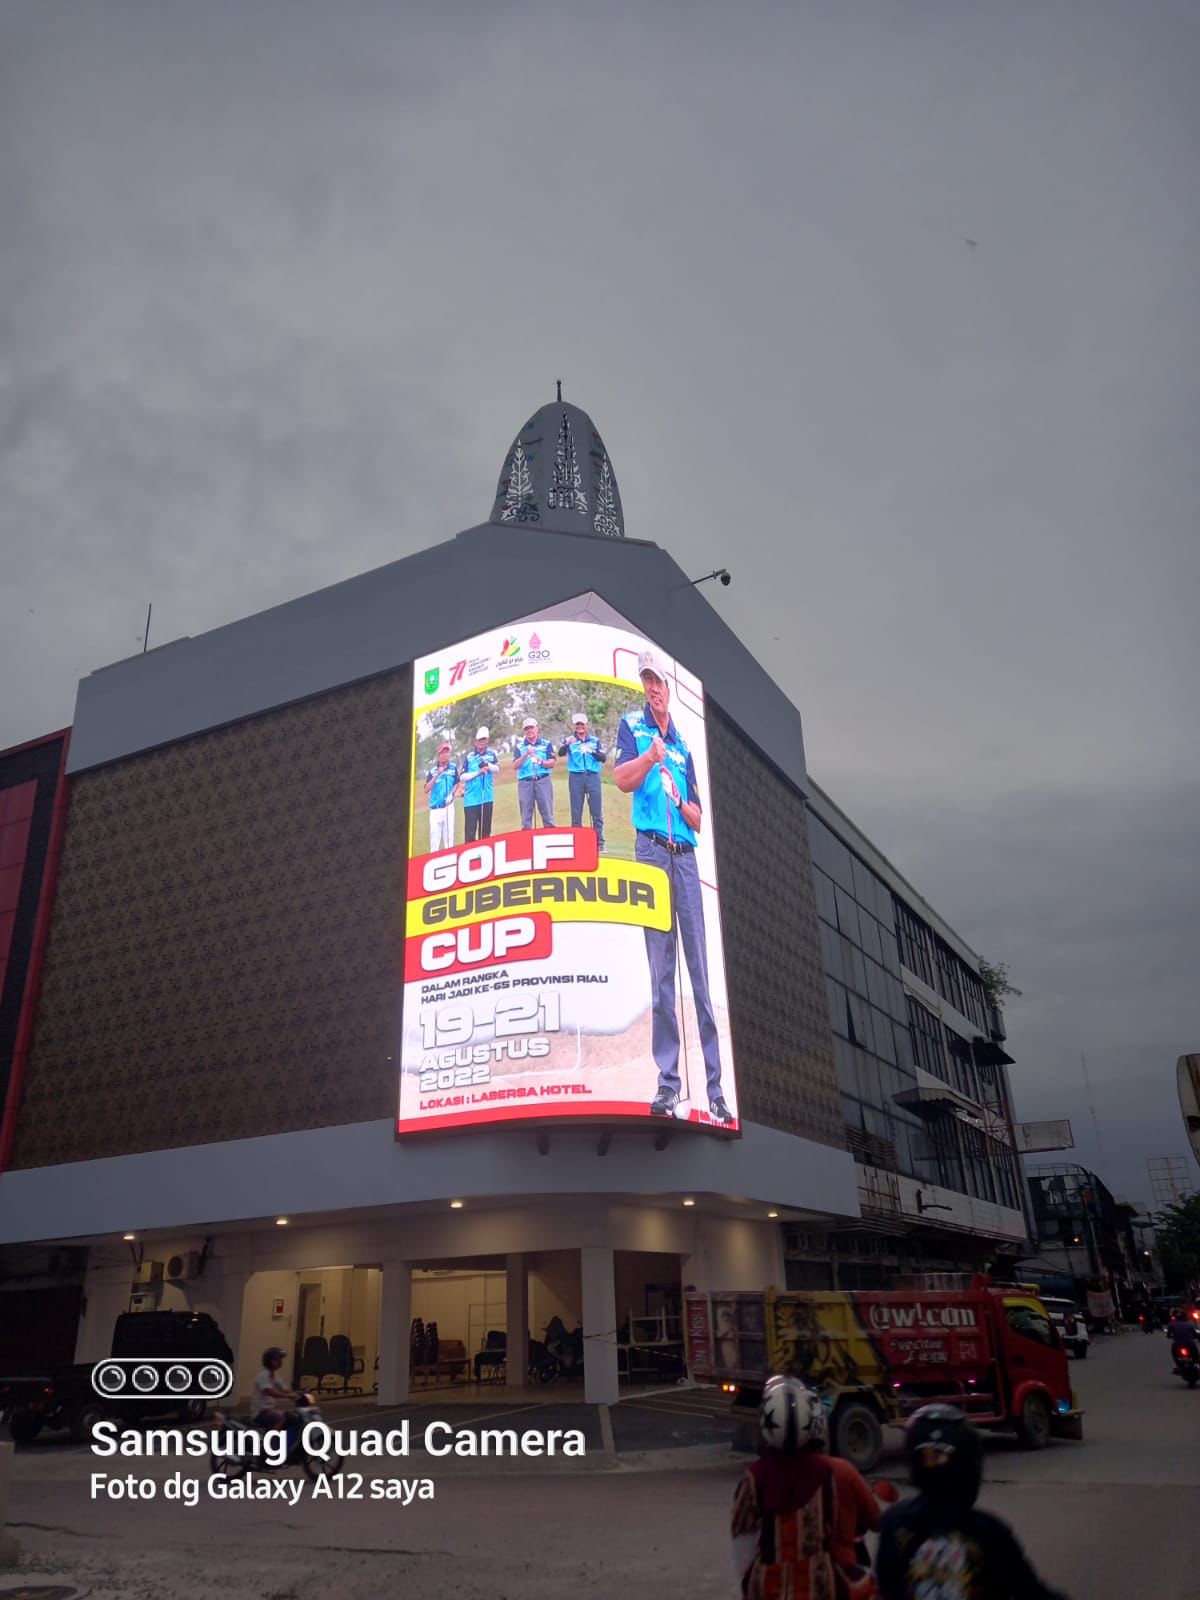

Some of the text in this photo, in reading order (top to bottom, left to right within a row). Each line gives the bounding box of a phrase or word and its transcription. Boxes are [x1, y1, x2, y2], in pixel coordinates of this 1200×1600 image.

[528, 649, 550, 659] G20
[422, 833, 575, 892] GOLF
[422, 876, 656, 925] GUBERNUR
[420, 916, 536, 972] CUP
[421, 969, 509, 994] DALAM RANGKA
[421, 974, 608, 1005] HARI JADI KE-65 PROVINSI RIAU
[419, 991, 561, 1050] 19-21
[419, 1037, 550, 1073] AGUSTUS
[419, 1064, 491, 1093] 2022
[419, 1095, 464, 1110] LOKASI
[471, 1086, 538, 1104] LABERSA
[540, 1084, 592, 1096] HOTEL
